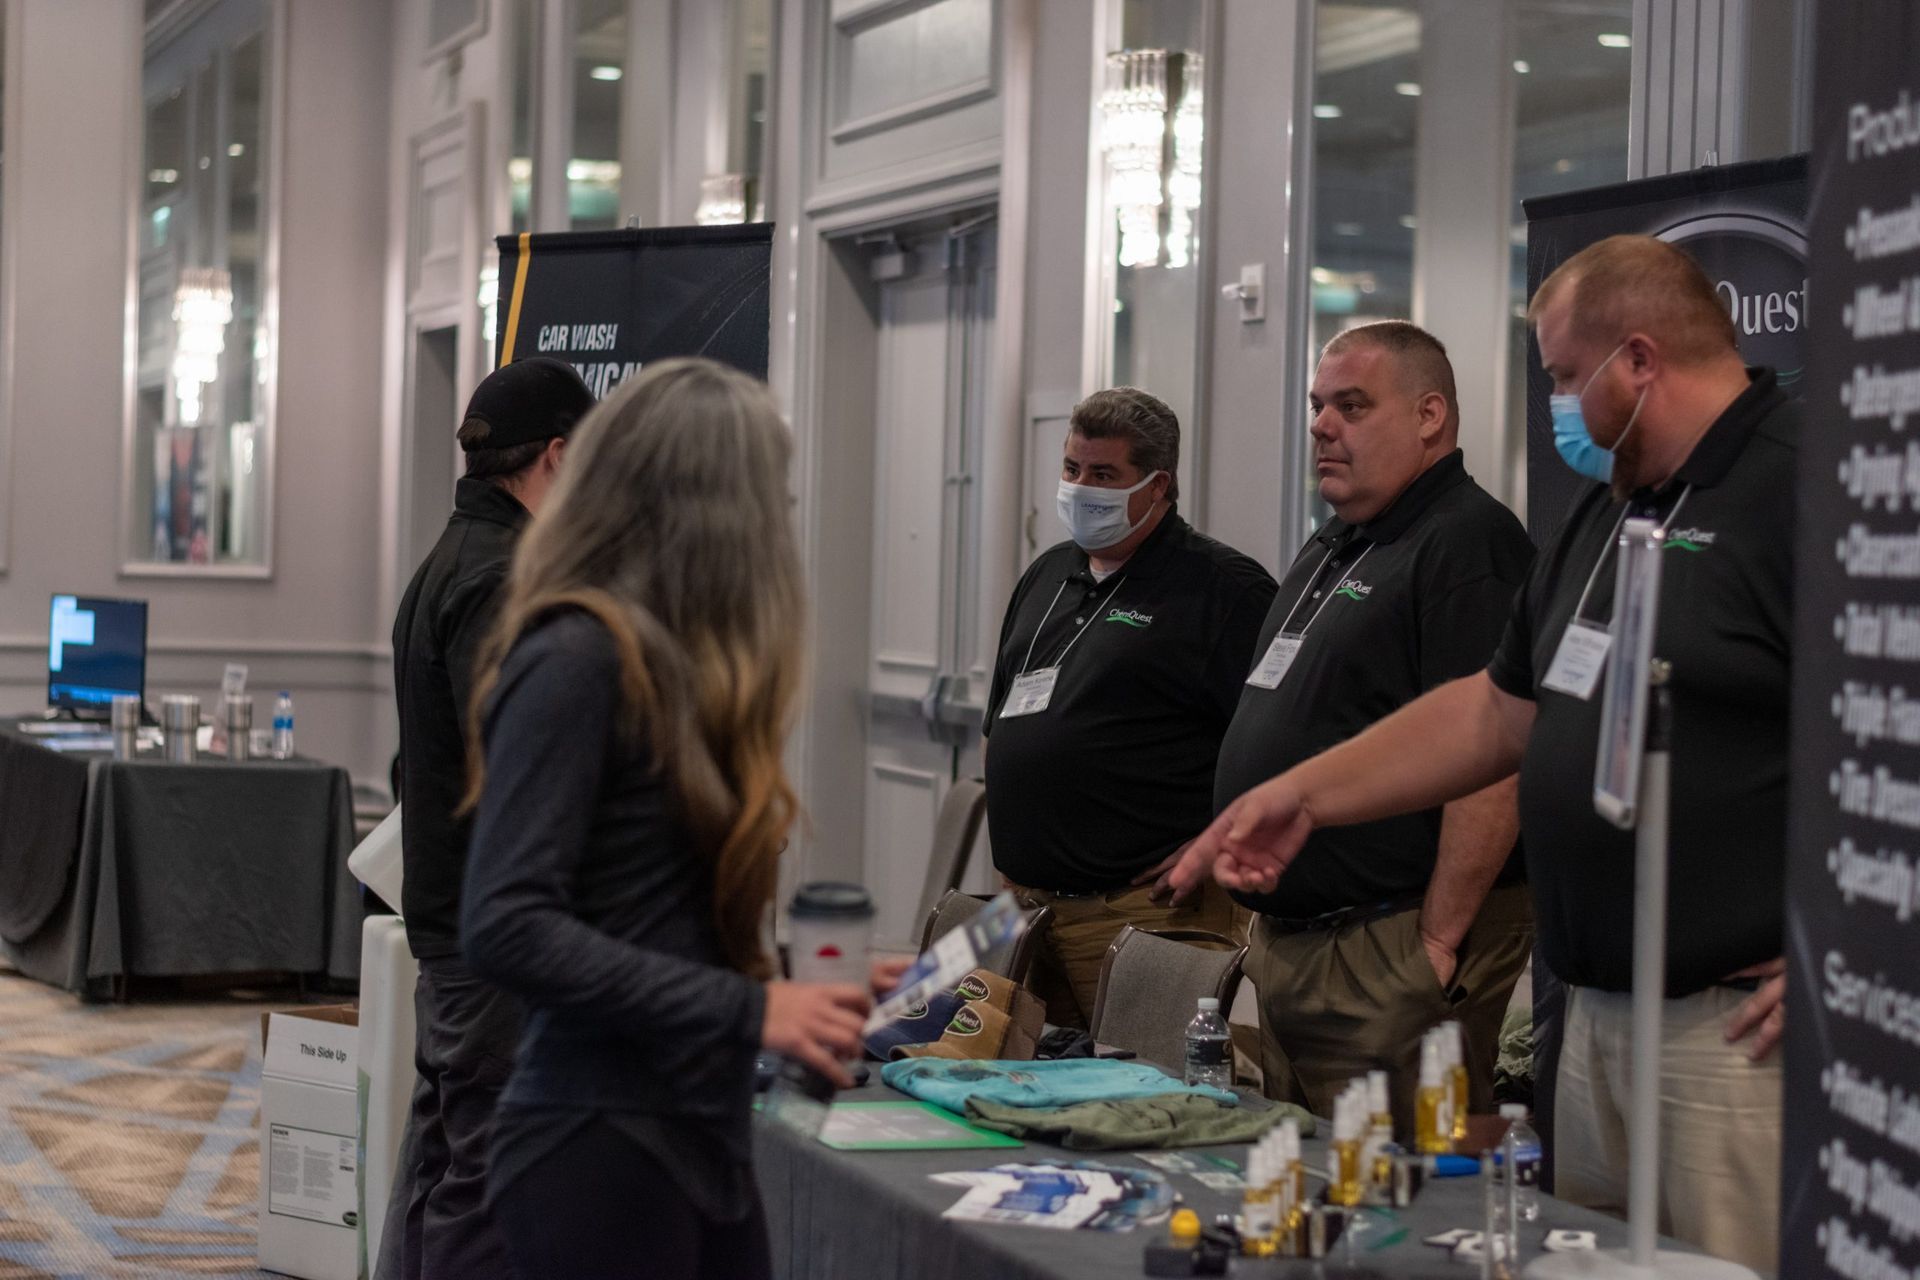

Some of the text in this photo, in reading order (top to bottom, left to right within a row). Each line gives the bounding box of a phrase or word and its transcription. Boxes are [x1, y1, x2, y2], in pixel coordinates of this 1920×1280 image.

[538, 323, 619, 352] CAR WASH
[569, 362, 643, 402] MICA
[1109, 608, 1153, 623] ChemQuest
[300, 1043, 347, 1064] This Side Up
